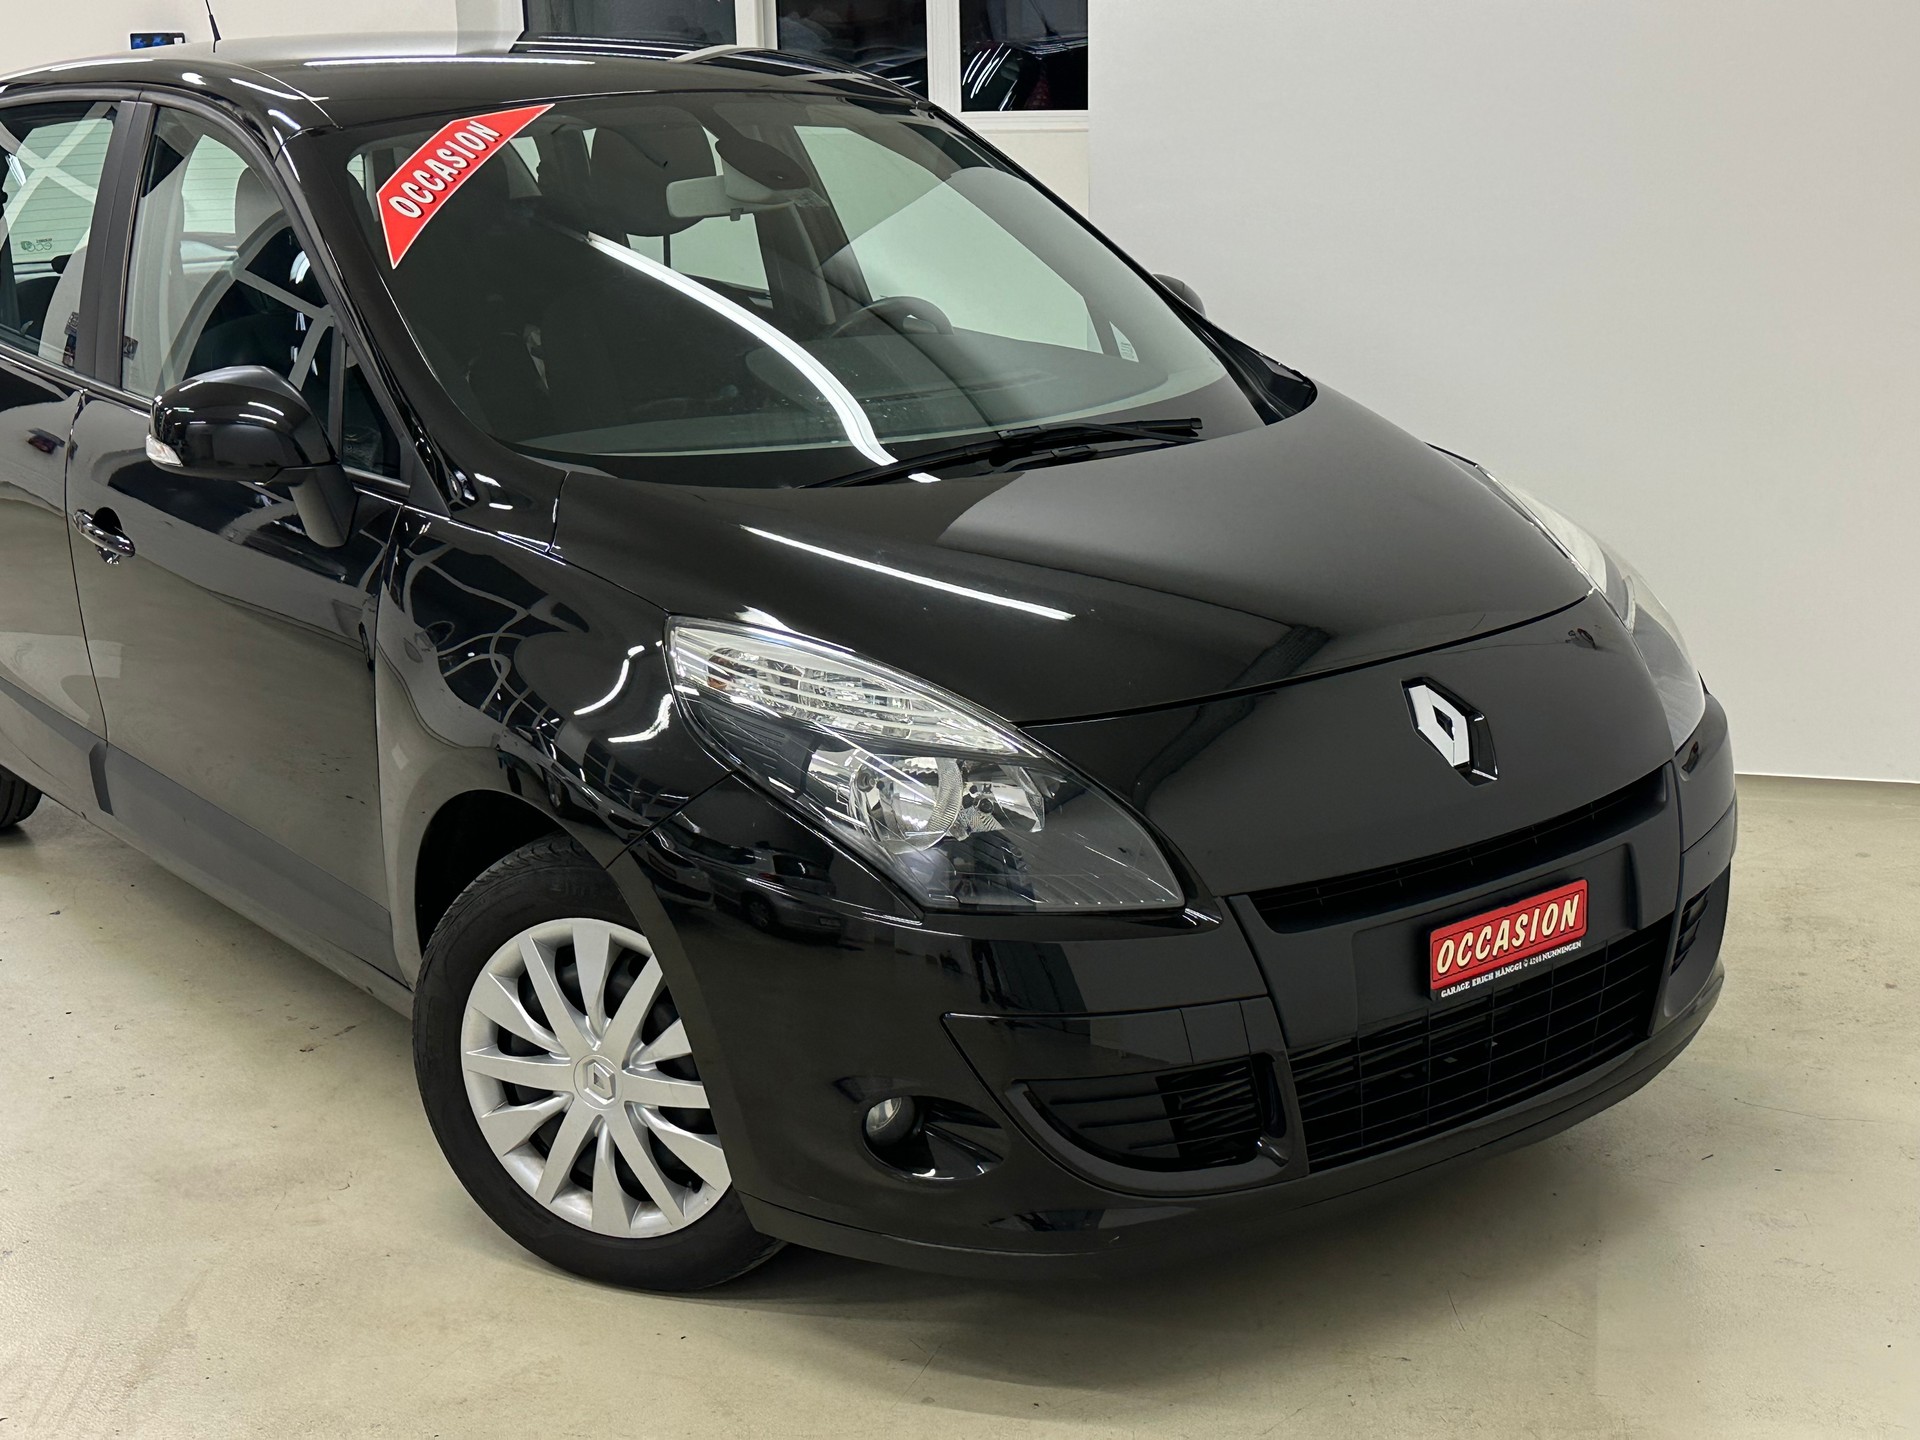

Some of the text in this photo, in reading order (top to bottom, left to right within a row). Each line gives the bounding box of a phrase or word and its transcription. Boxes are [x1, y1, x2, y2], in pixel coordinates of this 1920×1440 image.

[388, 120, 501, 218] OCCASION
[1436, 893, 1580, 974] OCCASION
[1440, 981, 1471, 997] GARAGE
[1471, 971, 1494, 987] ERICH
